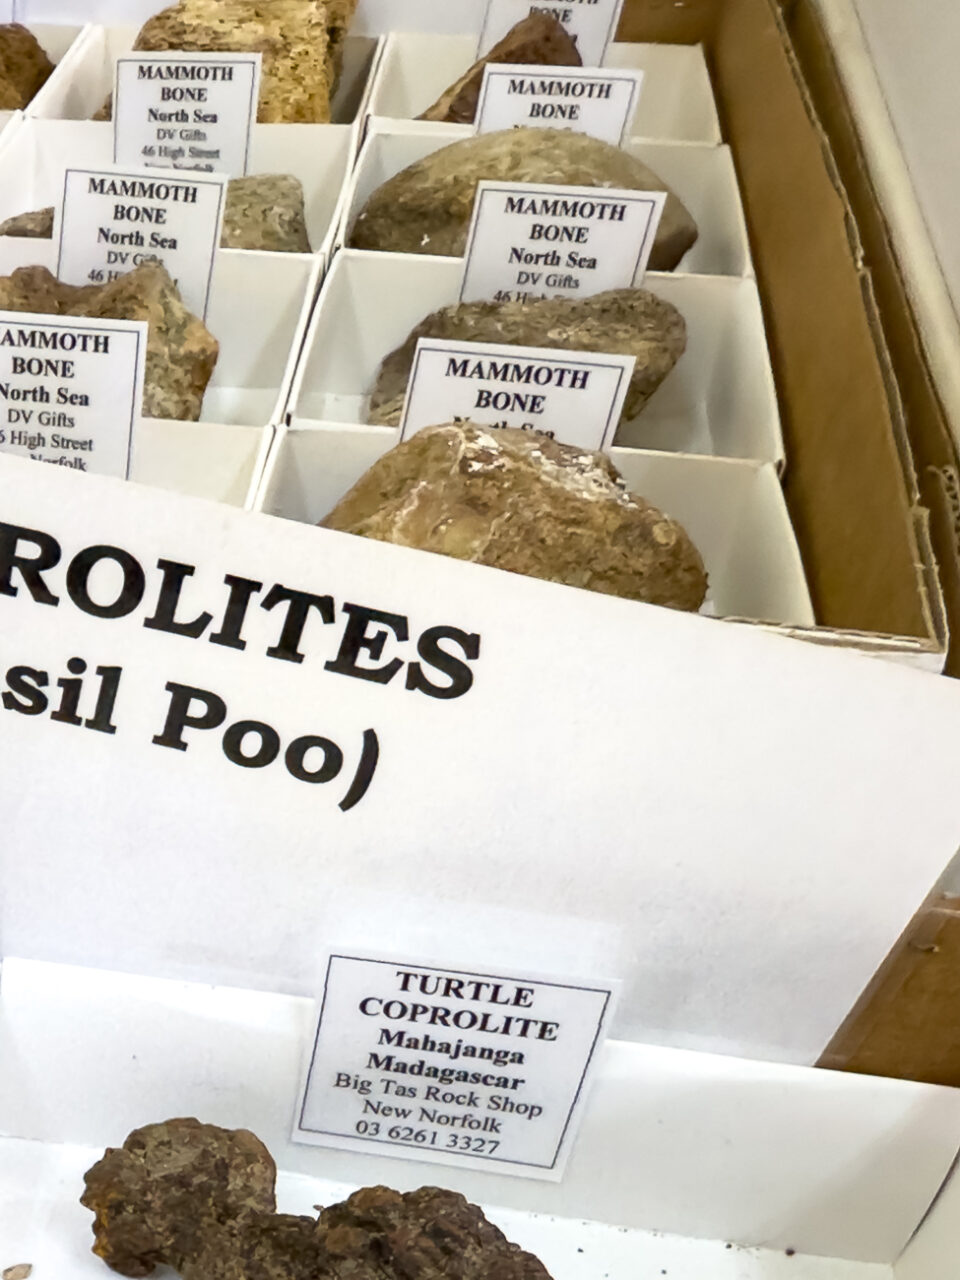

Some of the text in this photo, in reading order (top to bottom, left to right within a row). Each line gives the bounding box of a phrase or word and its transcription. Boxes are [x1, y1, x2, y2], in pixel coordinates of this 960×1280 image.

[137, 65, 233, 81] MAMMOTH
[160, 87, 208, 102] BONE
[508, 80, 612, 99] MAMMOTH
[148, 108, 218, 123] North Sea
[529, 103, 580, 120] BONE
[88, 178, 198, 203] MAMMOTH
[113, 205, 167, 224] BONE
[504, 197, 627, 221] MAMMOTH
[97, 228, 178, 250] North Sea
[529, 224, 589, 243] BONE
[107, 251, 129, 264] DV
[509, 248, 597, 269] North Sea
[88, 269, 103, 281] 46
[516, 271, 580, 289] DV Gifts
[12, 356, 75, 378] BONE
[445, 358, 592, 389] MAMMOTH
[57, 387, 90, 406] Sea
[475, 390, 547, 414] BONE
[8, 409, 75, 428] DV Gifts
[11, 430, 46, 450] High
[51, 435, 93, 451] Street
[30, 454, 87, 472] folk
[151, 681, 380, 812] Poo)
[396, 971, 535, 1008] TURTLE
[359, 997, 561, 1041] COPROLITE
[377, 1028, 524, 1066] Mahajanga
[366, 1053, 526, 1090] Madagascar
[333, 1072, 544, 1120] Big Tas Rock Shop
[362, 1100, 502, 1134] New Norfolk
[355, 1120, 500, 1154] 03 6261 3327
